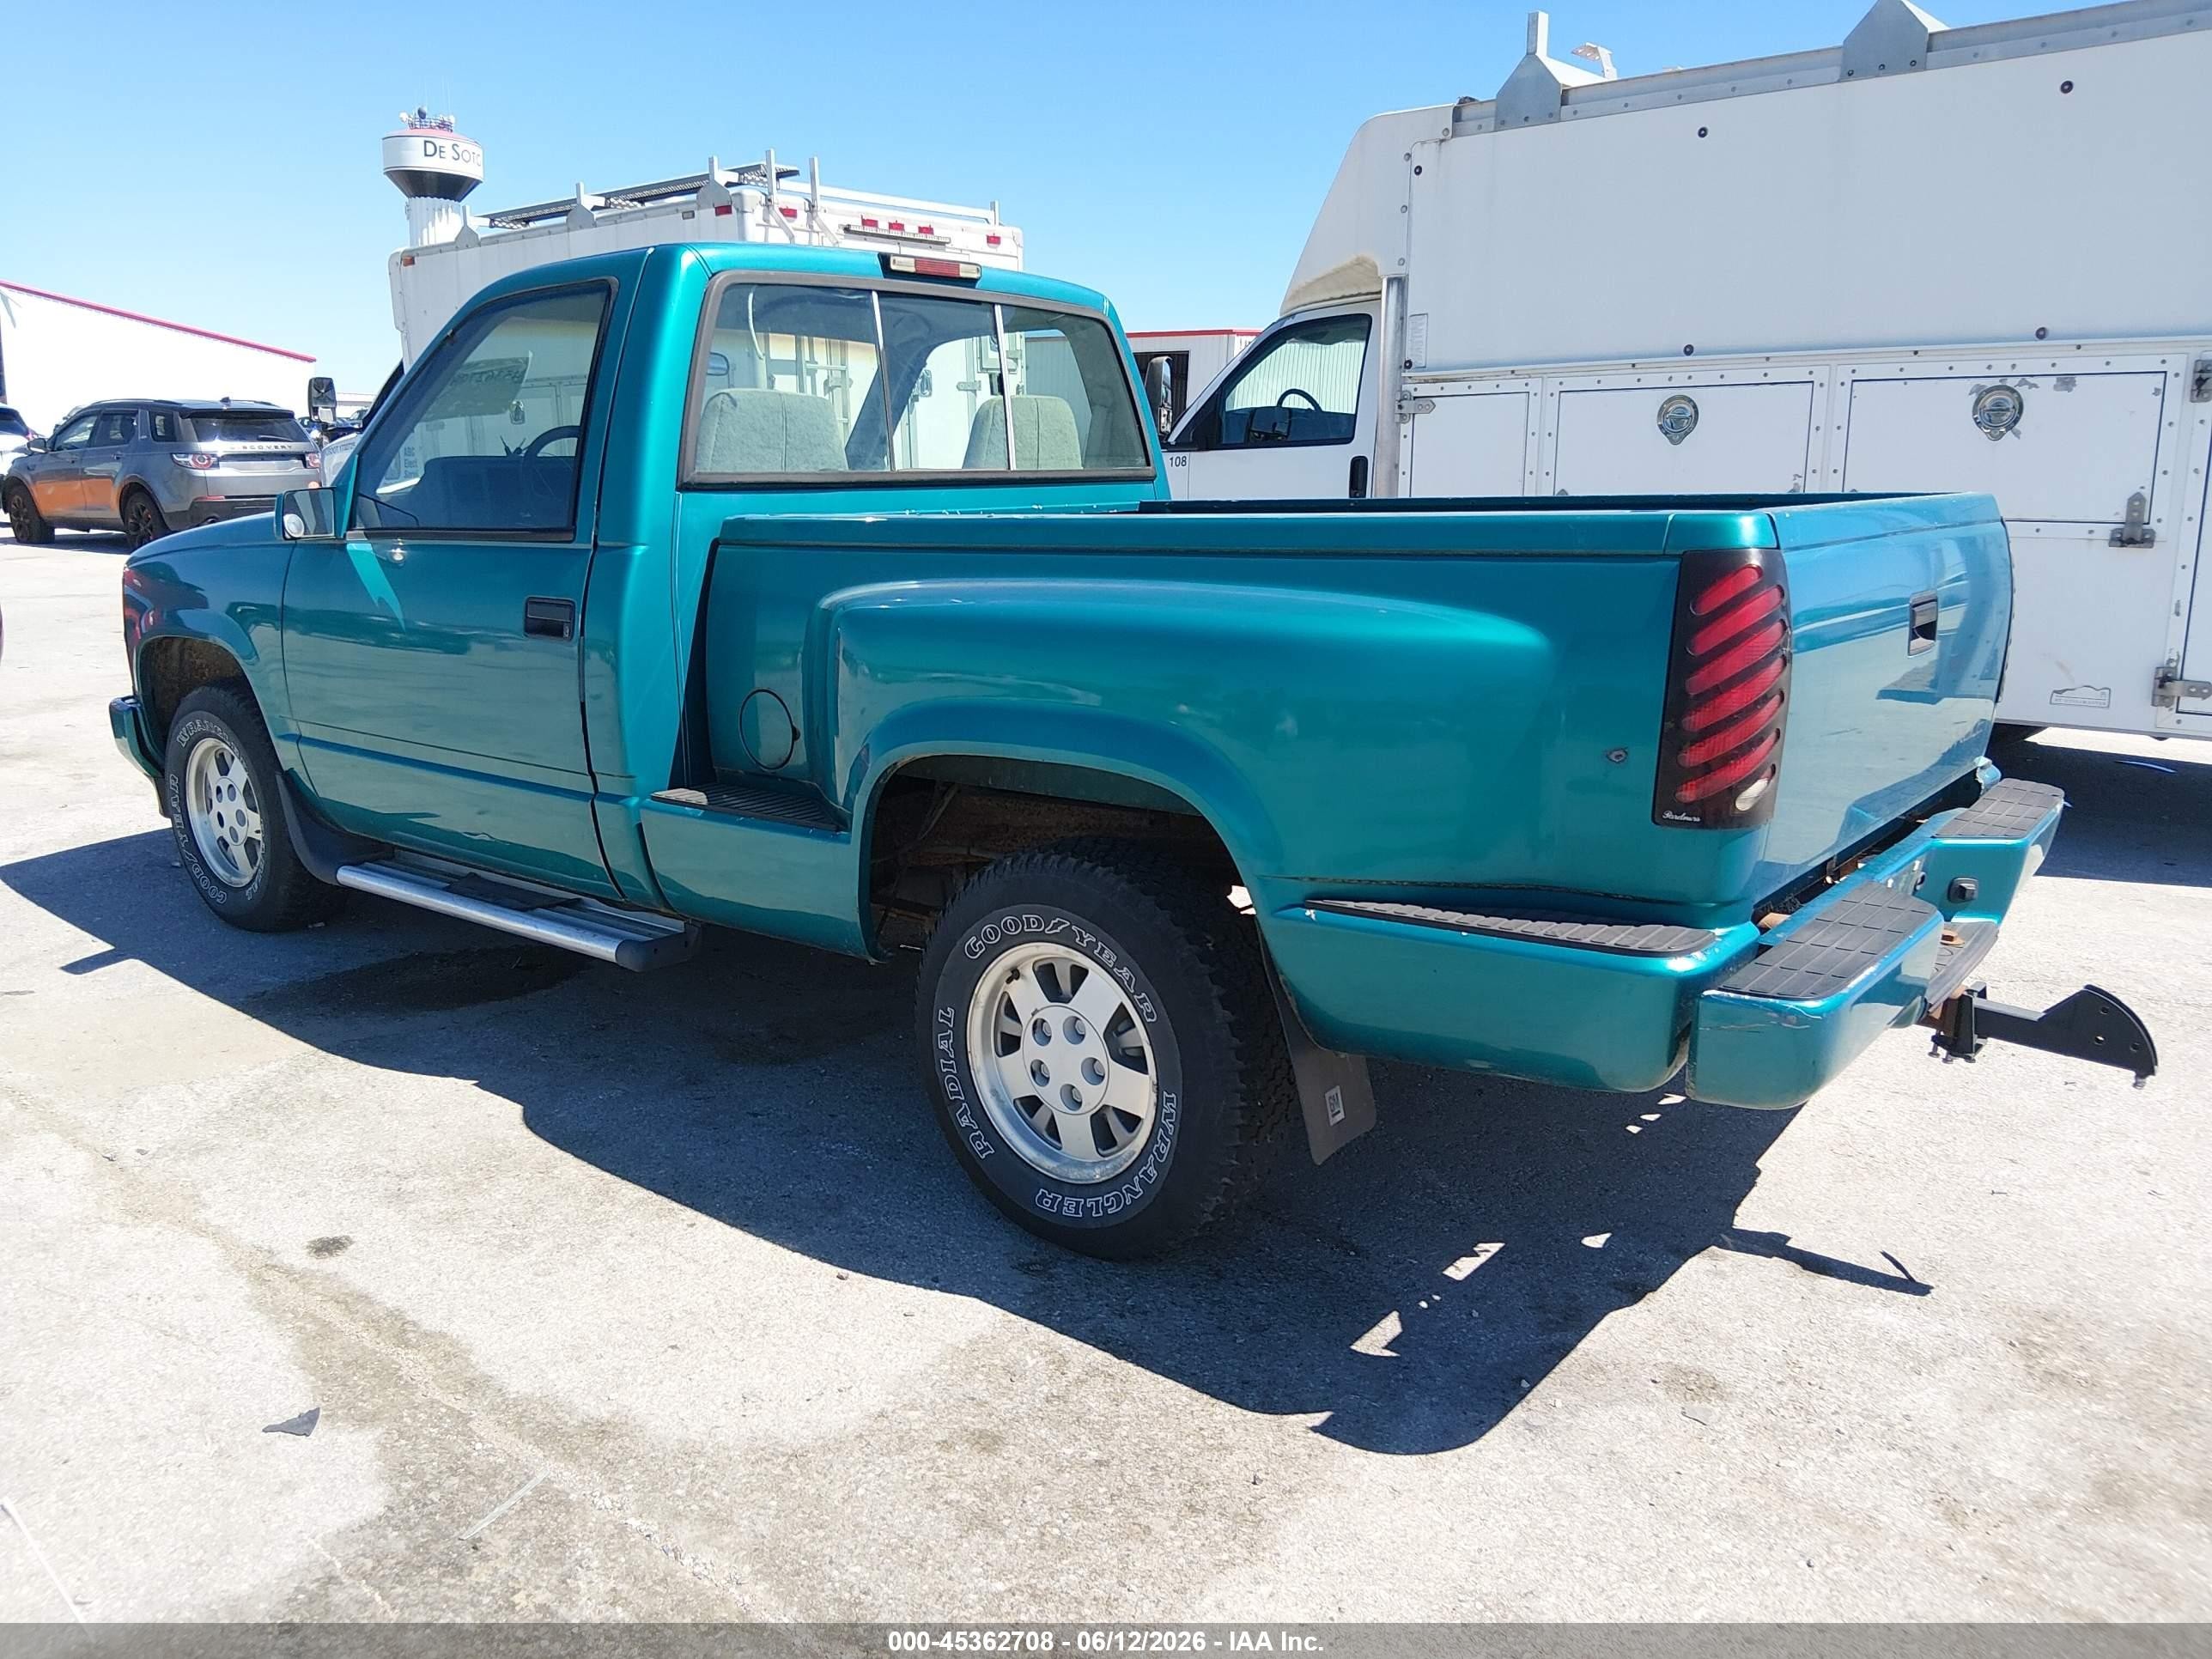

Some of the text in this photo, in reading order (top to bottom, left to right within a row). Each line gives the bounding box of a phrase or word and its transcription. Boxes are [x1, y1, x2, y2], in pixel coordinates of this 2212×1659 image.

[1169, 455, 1188, 468] 108
[964, 914, 1157, 1023] GOODYEAR
[933, 1006, 995, 1159] RADIAL
[1035, 1091, 1178, 1218] WRANGLER
